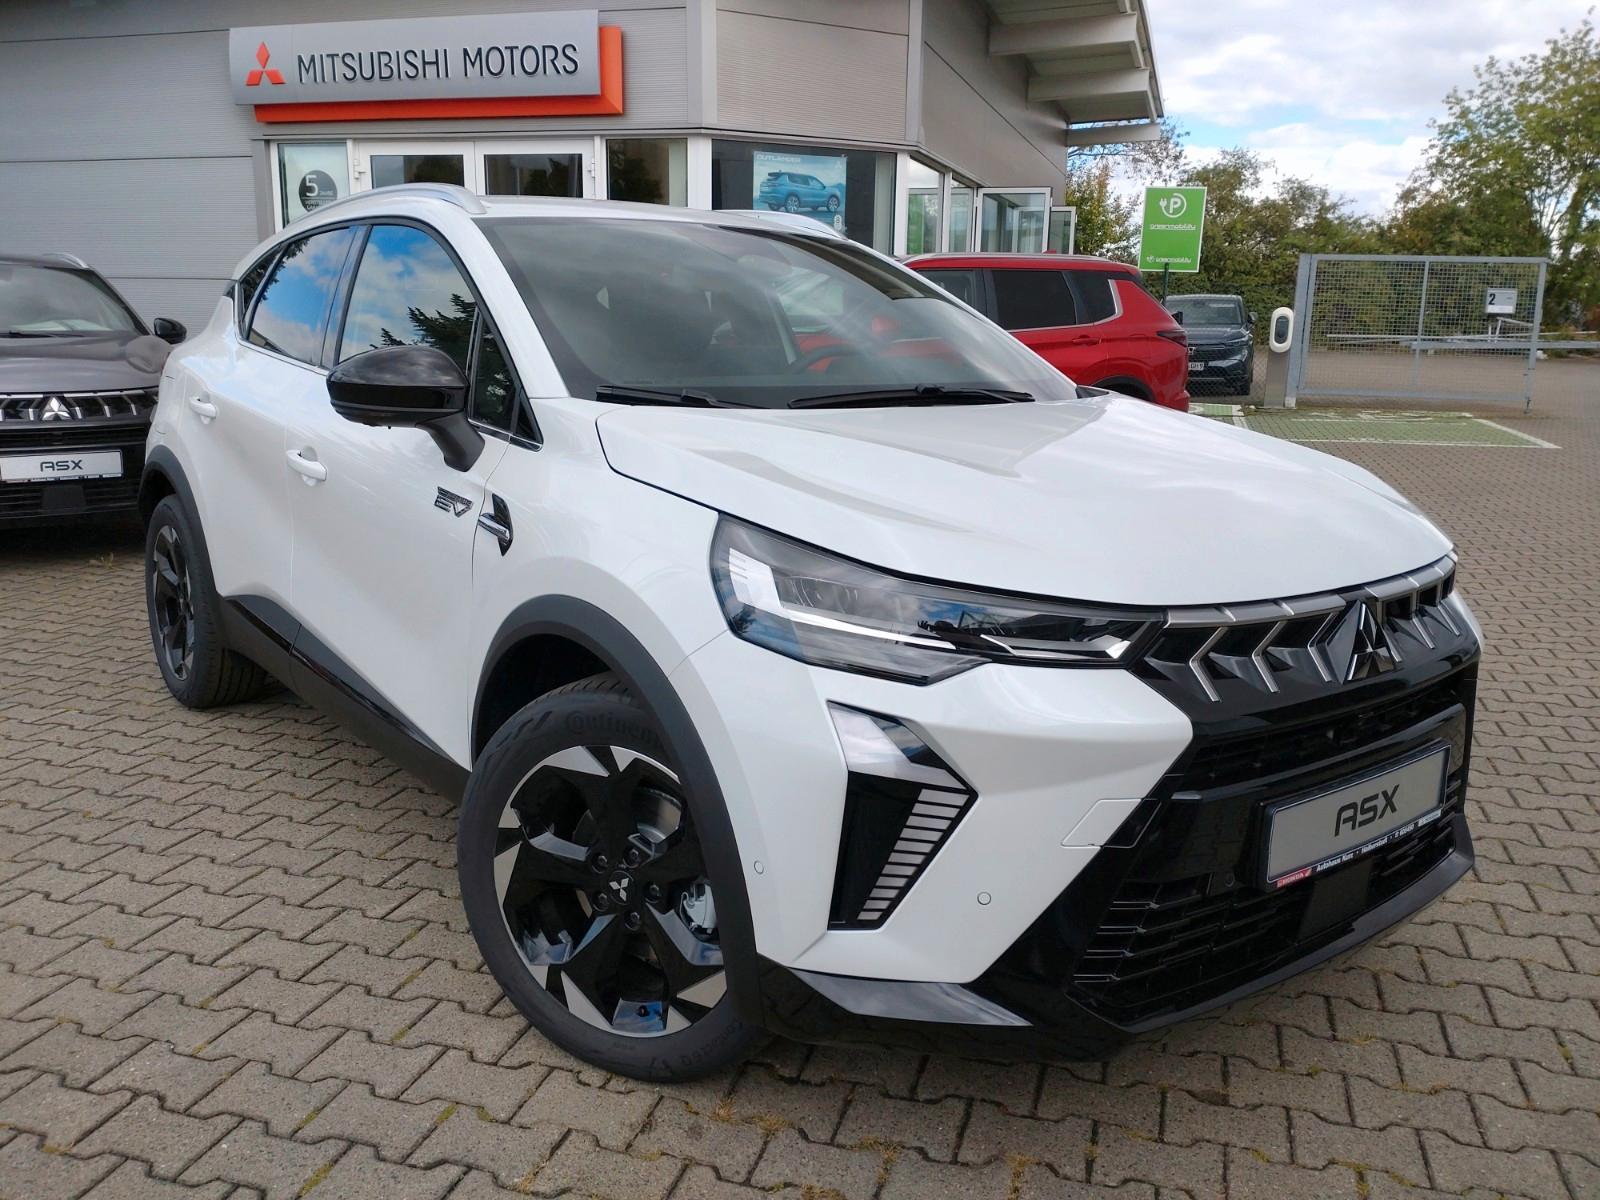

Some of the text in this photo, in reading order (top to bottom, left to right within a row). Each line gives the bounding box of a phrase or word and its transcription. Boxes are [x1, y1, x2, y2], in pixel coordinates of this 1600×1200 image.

[297, 43, 579, 84] MITSUBISHI MOTORS
[306, 174, 319, 197] 5
[1169, 197, 1182, 214] P
[1488, 293, 1496, 306] 2
[40, 459, 83, 472] ASX
[566, 710, 660, 744] Continen
[1334, 784, 1400, 837] ASX
